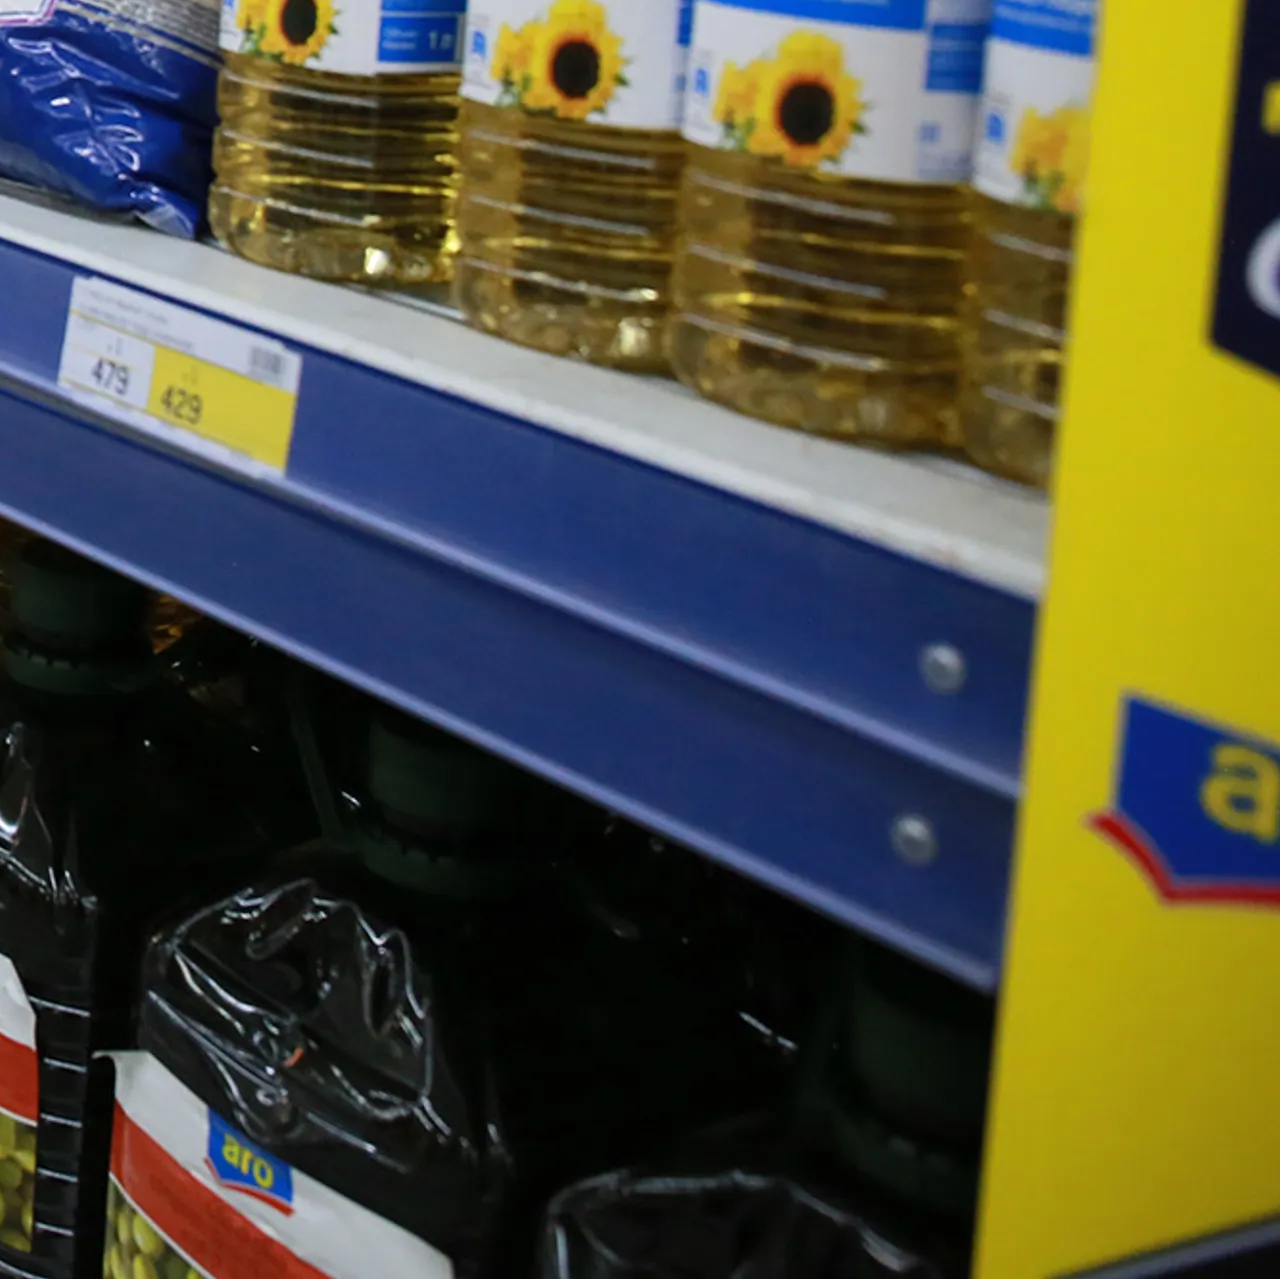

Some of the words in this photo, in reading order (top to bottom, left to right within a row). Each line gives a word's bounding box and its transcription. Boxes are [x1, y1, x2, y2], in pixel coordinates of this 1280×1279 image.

[93, 357, 130, 396] 479
[160, 384, 203, 426] 429
[221, 1133, 275, 1190] aro
